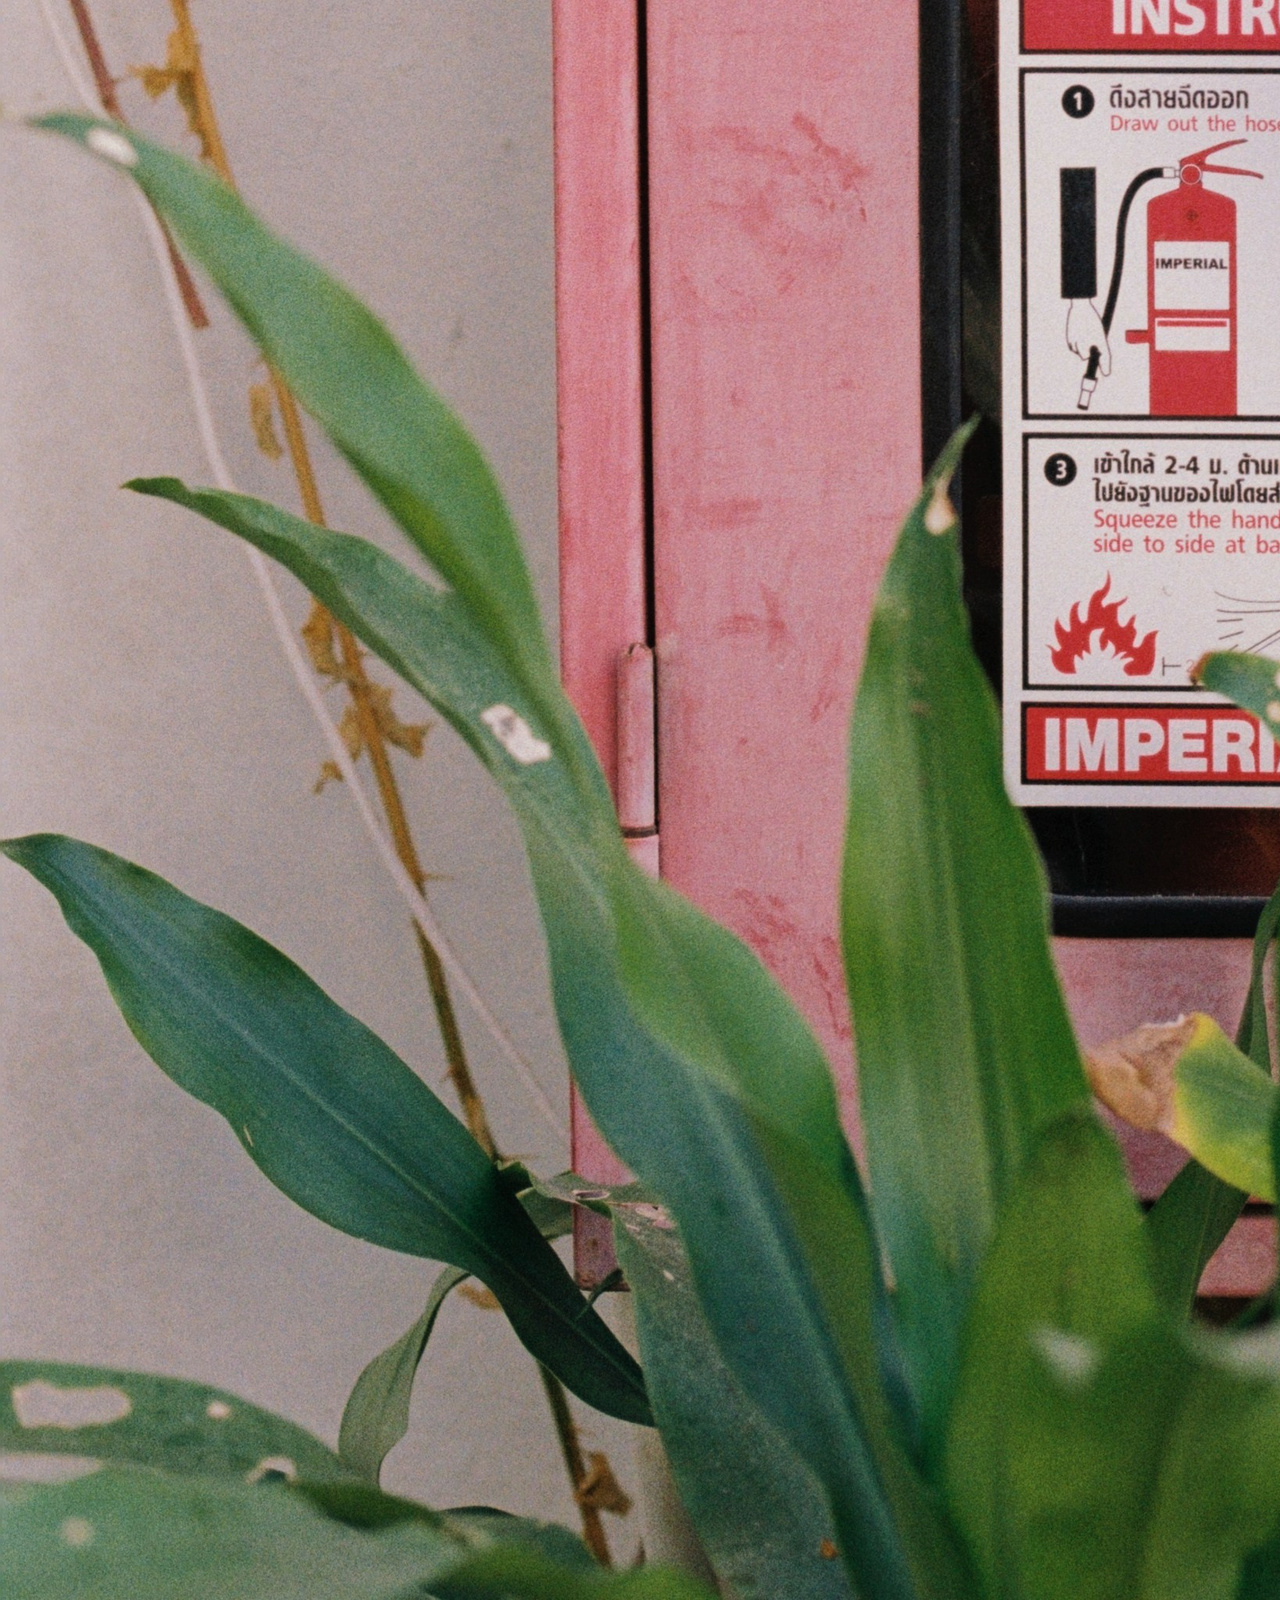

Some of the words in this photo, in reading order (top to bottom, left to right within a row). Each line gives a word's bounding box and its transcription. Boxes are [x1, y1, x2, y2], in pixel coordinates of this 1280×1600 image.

[1109, 83, 1249, 109] ดึงสายฉีดออก
[1110, 114, 1159, 132] Draw
[1167, 116, 1198, 132] out
[1207, 114, 1237, 132] the
[1155, 258, 1228, 270] IMPERIAL
[1094, 448, 1156, 474] เข้าใกล้
[1164, 455, 1200, 475] 2-4
[1209, 457, 1228, 475] ม.
[1093, 508, 1178, 532] Squeeze
[1187, 509, 1222, 529] the
[1093, 532, 1134, 553] side
[1143, 535, 1165, 554] to
[1174, 533, 1215, 554] side
[1225, 536, 1246, 554] at
